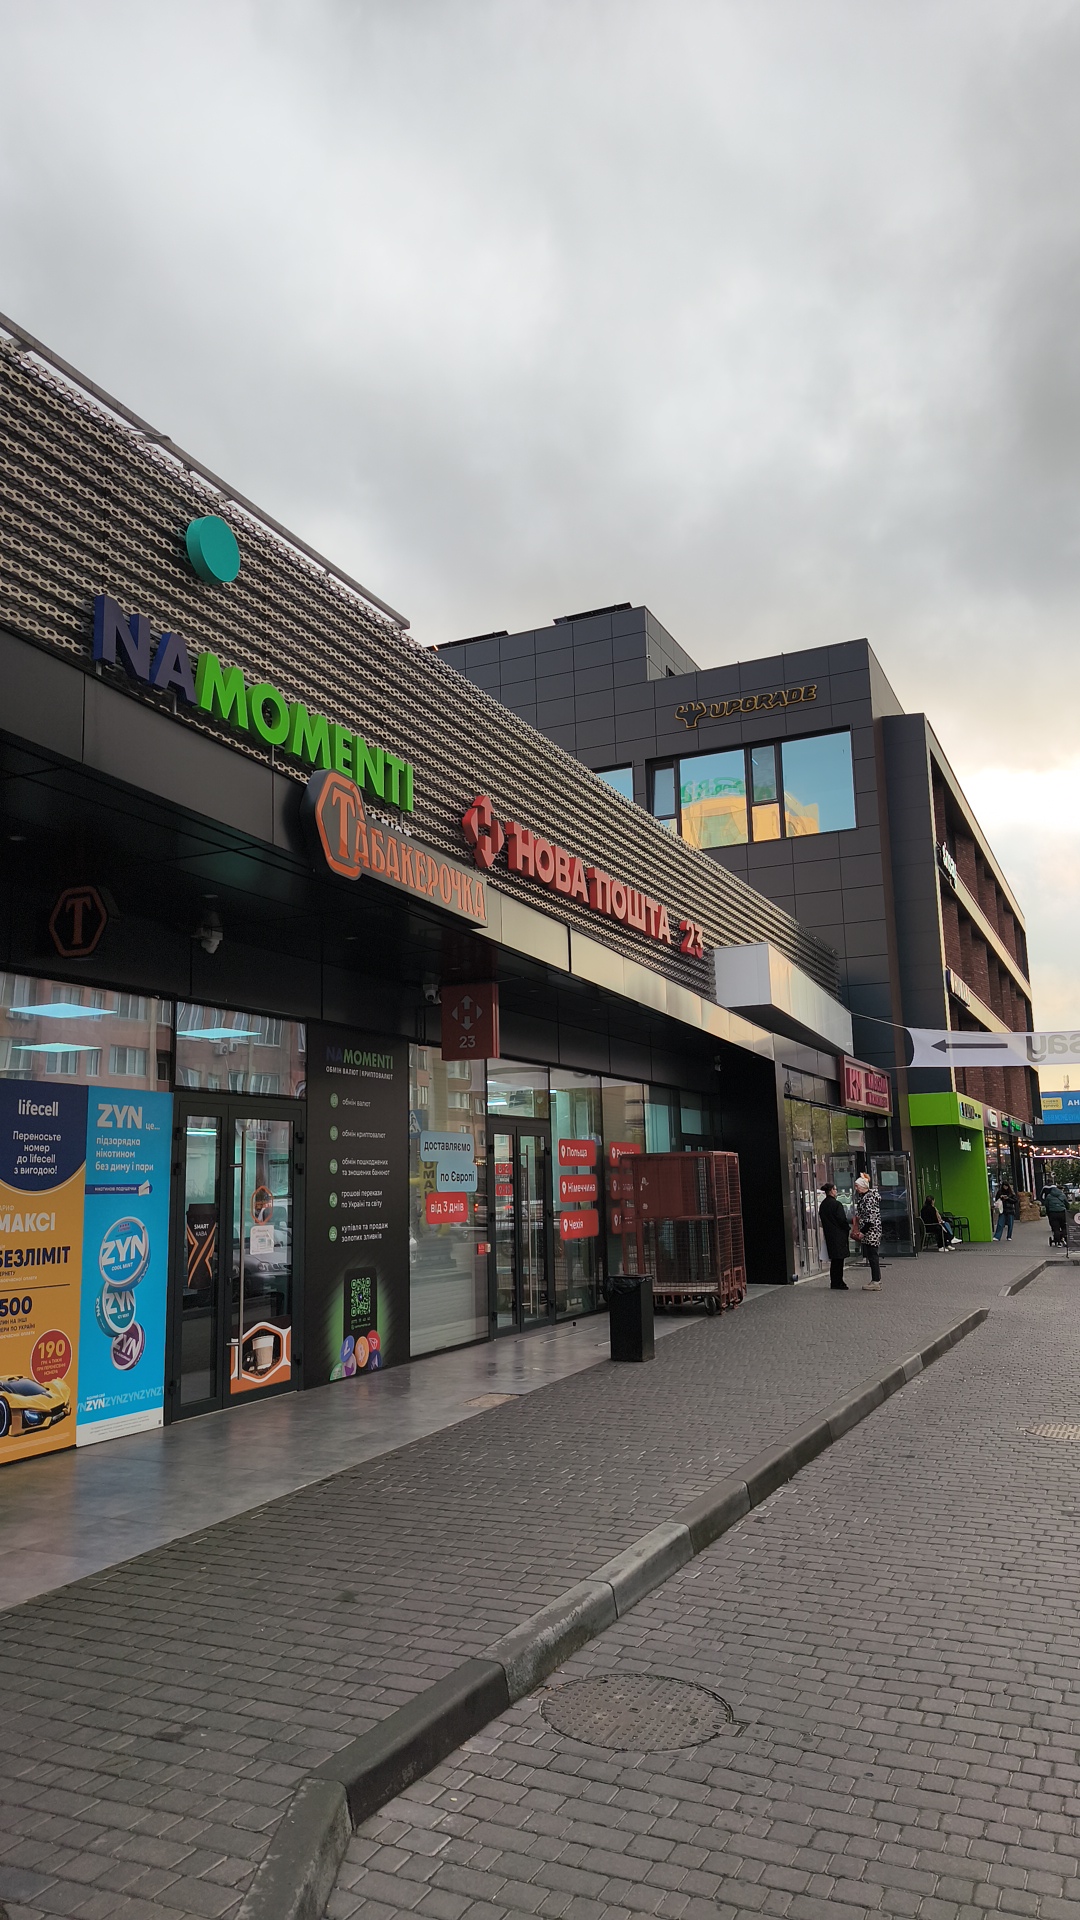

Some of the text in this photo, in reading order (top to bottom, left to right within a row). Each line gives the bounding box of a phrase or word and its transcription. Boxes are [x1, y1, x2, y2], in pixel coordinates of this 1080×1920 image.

[93, 594, 414, 812] NAMOMENTI
[709, 684, 818, 718] UPGRADE
[332, 787, 486, 920] ТАБАКЕРОЧКА
[505, 821, 703, 959] НОВА ПОШТА 23
[459, 1035, 476, 1049] 23
[326, 1046, 393, 1069] NAMOMENTI
[325, 1066, 393, 1080] ОБМІН ВАЛЮТ КРИПТОВАЛЮТ
[18, 1099, 59, 1116] lifecell
[342, 1098, 356, 1106] обмін
[97, 1103, 142, 1129] ZYN
[12, 1131, 61, 1142] Переносьте
[96, 1135, 140, 1147] підзарядка
[342, 1130, 356, 1138] обмін
[24, 1145, 50, 1153] номер
[96, 1148, 135, 1158] нікотином
[424, 1141, 471, 1152] доставляємо
[566, 1147, 588, 1157] Польща
[17, 1154, 56, 1164] до lifecell
[20, 1165, 57, 1176] вигодою!
[95, 1161, 108, 1171] без
[110, 1163, 131, 1173] диму
[135, 1164, 153, 1173] пари
[440, 1170, 475, 1184] по Європі
[567, 1183, 596, 1193] Німеччина
[430, 1200, 464, 1214] від 3 днів
[569, 1219, 583, 1229] Чехія
[101, 1234, 144, 1266] ZYN
[105, 1291, 135, 1314] ZYN
[38, 1339, 65, 1359] 190
[112, 1333, 139, 1358] ZYN
